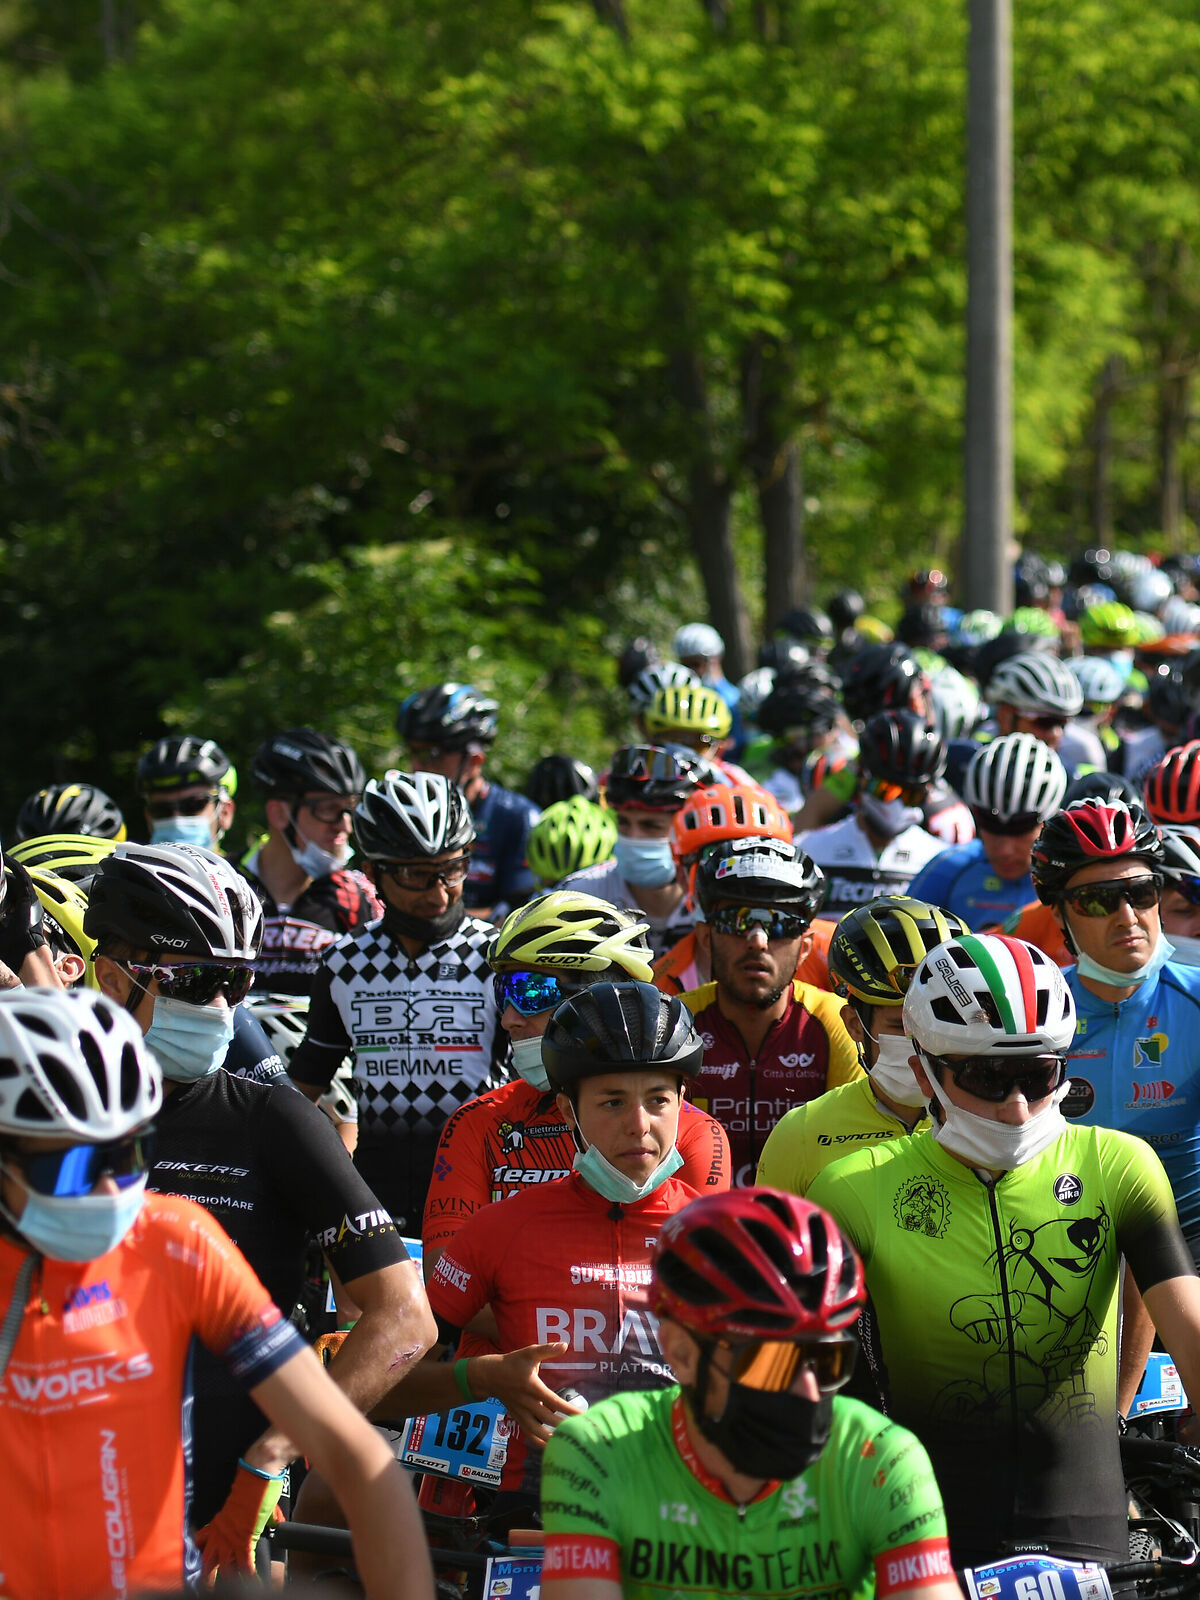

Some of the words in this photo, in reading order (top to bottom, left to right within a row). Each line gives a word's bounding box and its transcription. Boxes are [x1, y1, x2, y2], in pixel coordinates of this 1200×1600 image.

[535, 956, 590, 964] RUDY
[935, 958, 973, 1008] SALICE
[354, 990, 420, 999] Factory
[425, 989, 484, 998] Team
[355, 1033, 413, 1047] Black
[417, 1032, 480, 1046] Road
[366, 1059, 464, 1077] BIEMME
[705, 1119, 724, 1186] Formula
[153, 1160, 250, 1178] BIKER'S
[492, 1164, 572, 1184] Team
[1058, 1189, 1080, 1200] alka
[600, 1282, 640, 1292] TEAM
[434, 1409, 491, 1457] 132
[413, 1458, 448, 1469] SCOTT
[471, 1470, 500, 1481] BALDONI
